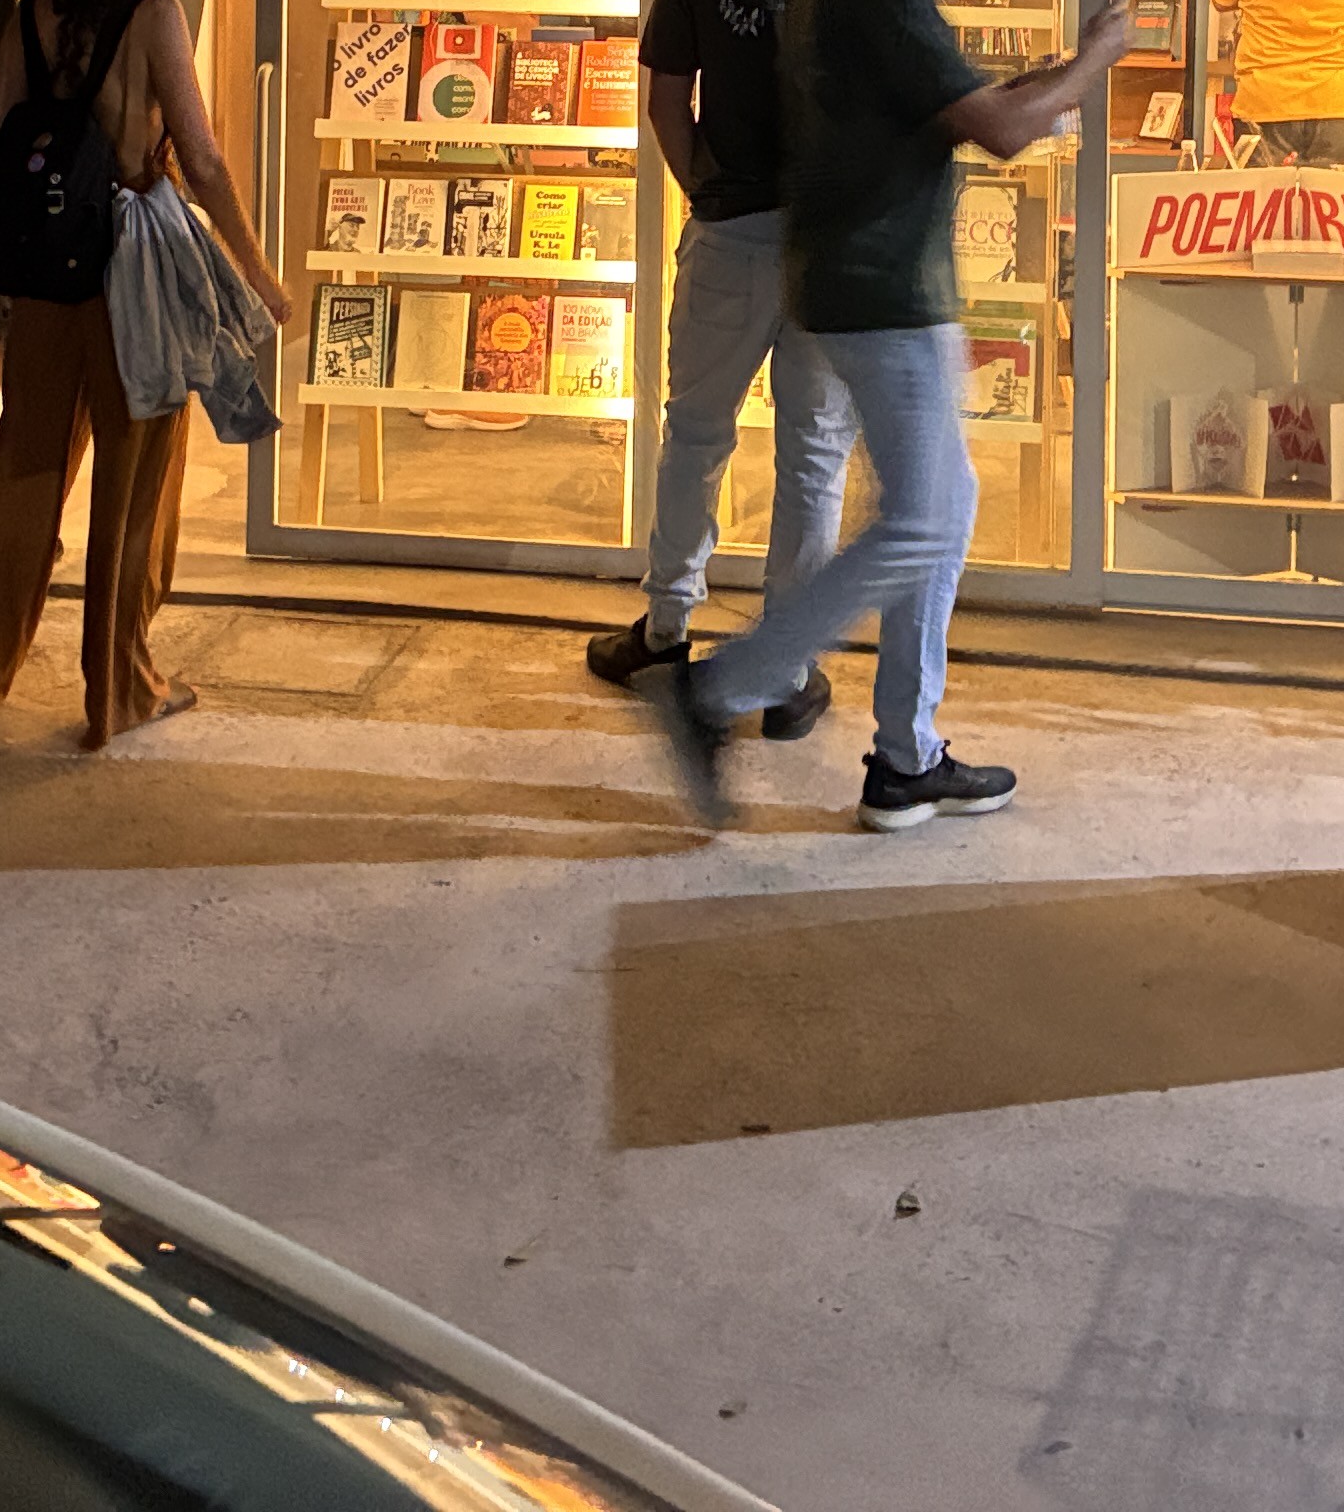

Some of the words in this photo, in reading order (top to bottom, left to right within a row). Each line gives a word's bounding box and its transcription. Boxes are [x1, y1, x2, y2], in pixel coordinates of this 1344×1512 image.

[340, 23, 381, 59] livro
[344, 66, 367, 88] de
[367, 24, 411, 67] fazer
[585, 67, 632, 79] Escrever
[354, 63, 404, 107] livros
[408, 184, 434, 195] Book
[536, 190, 566, 199] Como
[537, 201, 564, 209] criar
[530, 230, 565, 239] Ursula
[951, 220, 1012, 244] ECO
[533, 240, 544, 249] K.
[548, 240, 560, 249] Le
[532, 250, 559, 259] Guin
[562, 315, 574, 325] DA
[561, 327, 575, 336] NO
